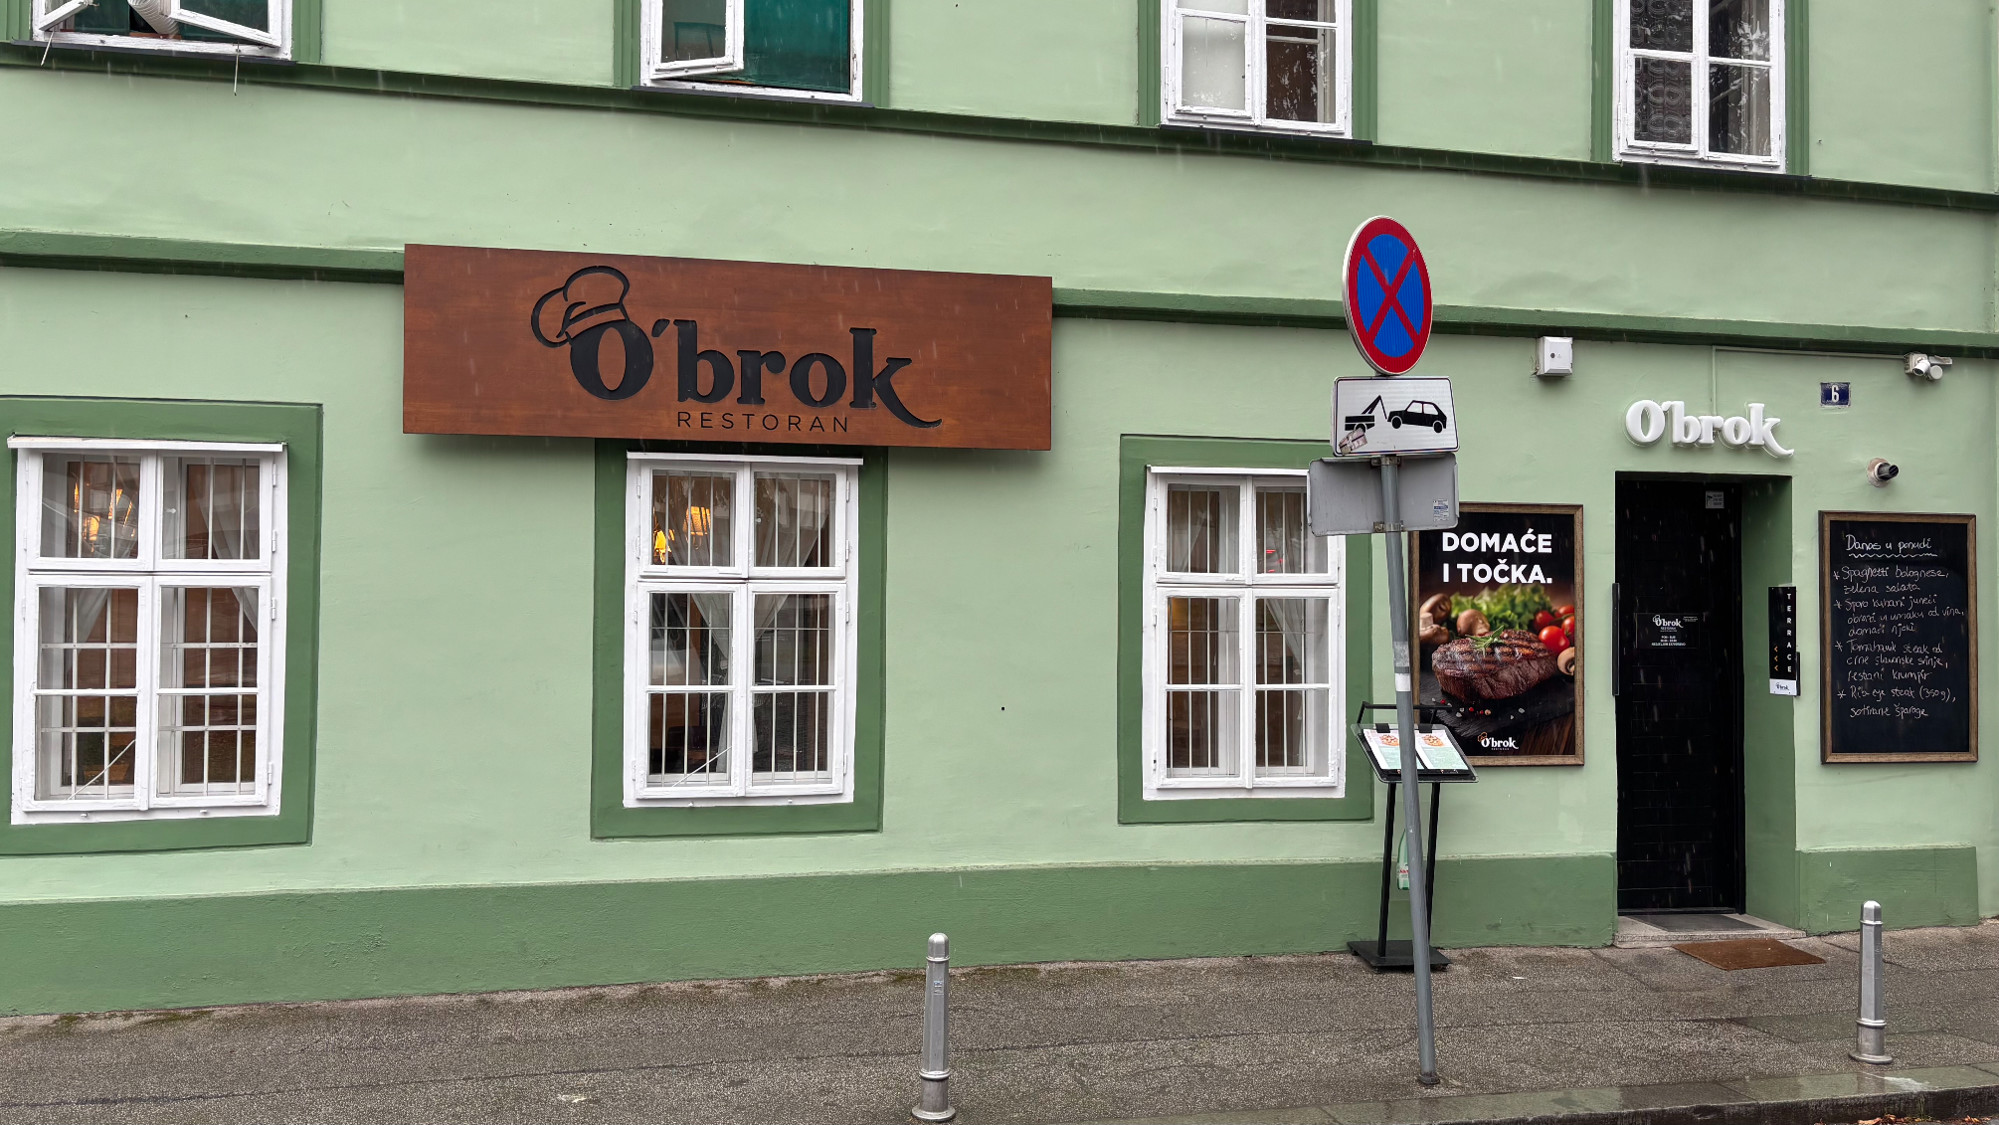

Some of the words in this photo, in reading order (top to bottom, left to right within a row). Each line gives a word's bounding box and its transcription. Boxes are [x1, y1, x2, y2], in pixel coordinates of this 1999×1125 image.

[1831, 384, 1840, 402] 6
[677, 411, 849, 432] RESTORAN
[1625, 399, 1795, 458] O'brok
[1442, 528, 1553, 554] DOMAĆE
[1845, 534, 1881, 550] Danas
[1885, 541, 1892, 550] u
[1898, 537, 1931, 553] ponudi
[1443, 564, 1450, 583] I
[1457, 559, 1553, 584] TOČKA.
[1841, 565, 1888, 583] Spaghetti
[1885, 582, 1920, 594] salata
[1927, 606, 1939, 618] od
[1931, 642, 1943, 654] od
[1846, 655, 1869, 666] crne
[1890, 686, 1915, 699] steak
